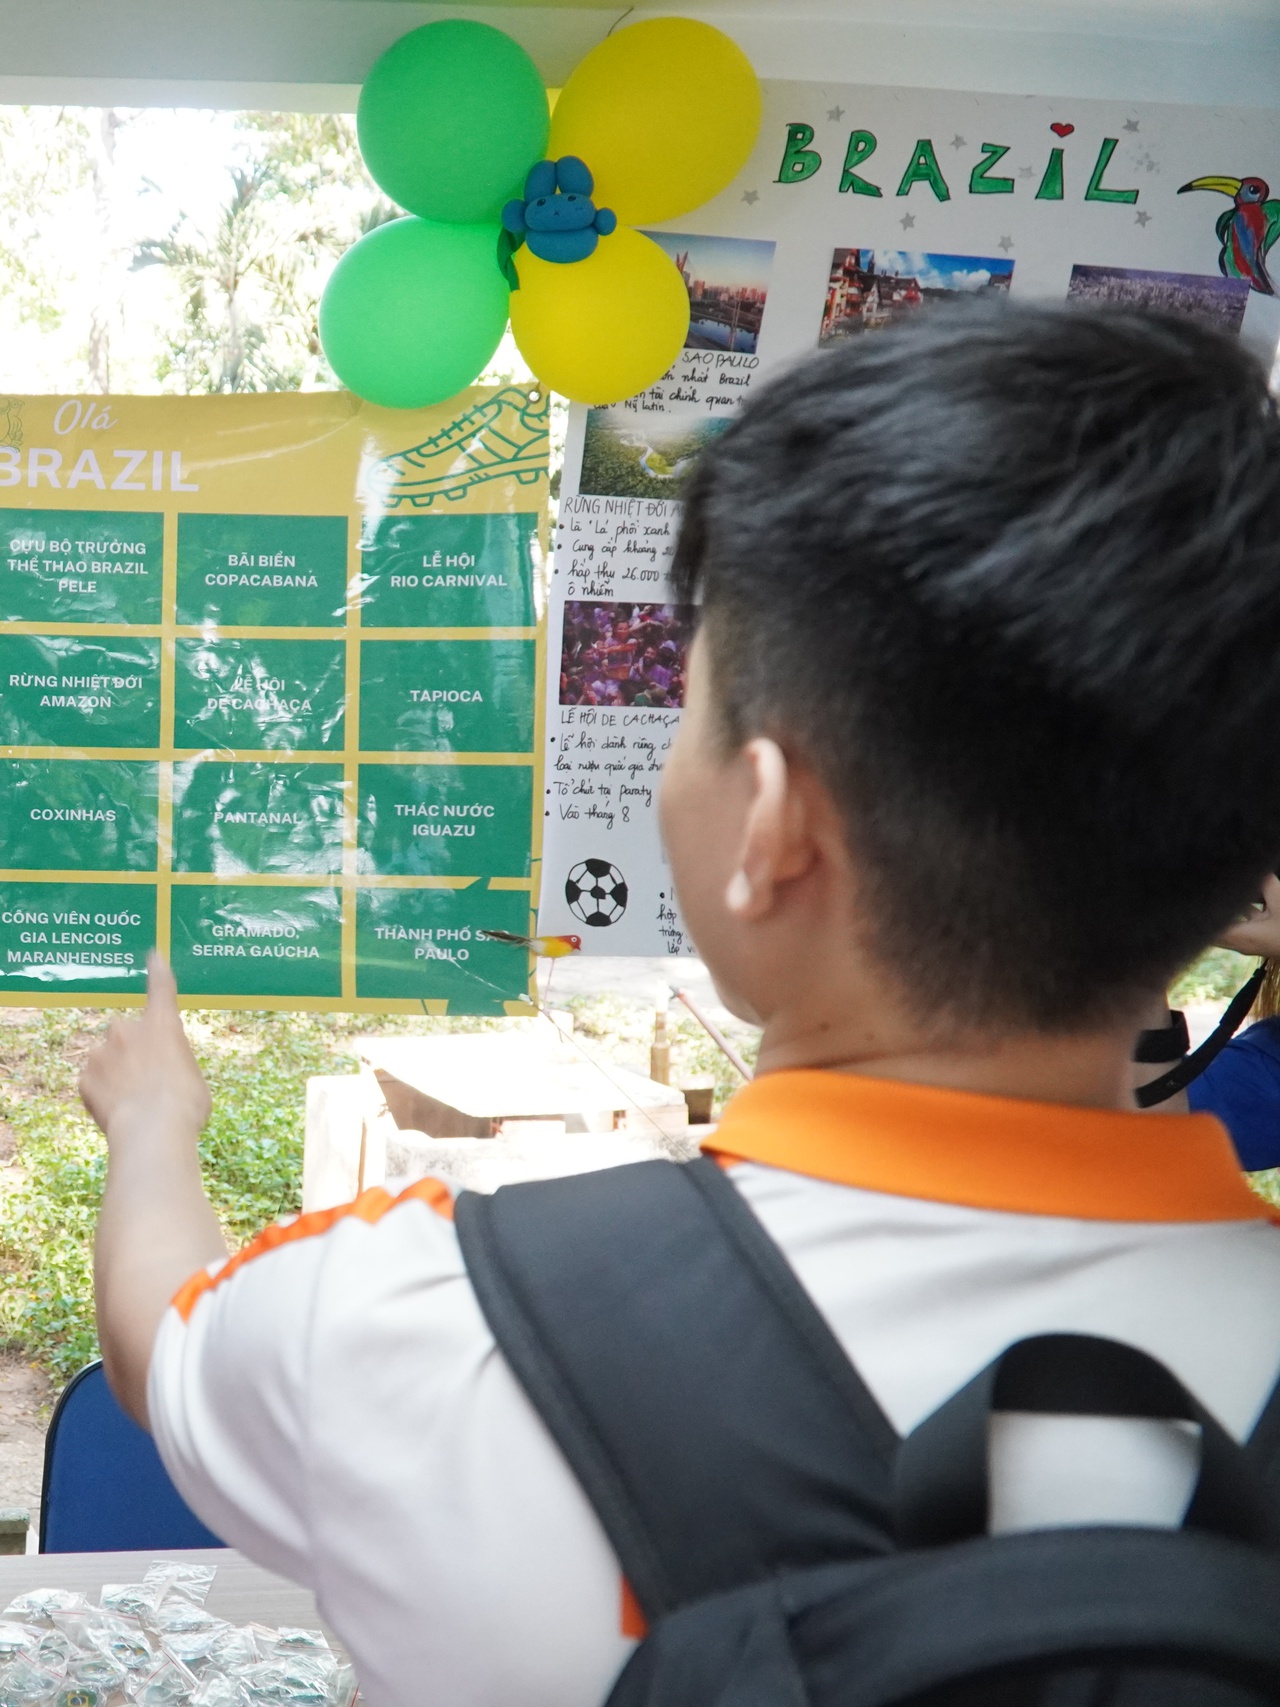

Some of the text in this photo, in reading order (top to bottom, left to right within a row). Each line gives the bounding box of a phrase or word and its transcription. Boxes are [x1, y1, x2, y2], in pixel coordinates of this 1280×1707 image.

[682, 353, 759, 368] SAO PAULO
[719, 370, 751, 386] Brazil
[54, 400, 119, 435] Olá
[644, 523, 670, 535] xanh
[10, 538, 146, 555] CỰU BỘ TRƯỞNG
[572, 539, 594, 560] Cung
[7, 555, 148, 574] THỂ THAO BRAZIL
[228, 551, 295, 567] BÃI BIỂN
[423, 551, 475, 569] LỄ HỘI
[58, 580, 96, 592] PELE
[205, 574, 318, 587] COPACABANA
[391, 574, 507, 586] RIO CARNIVAL
[10, 672, 142, 690] RỪNG NHIỆT ĐỚI
[40, 695, 111, 707] AMAZON
[410, 690, 482, 701] TAPIOCA
[208, 698, 312, 713] DE CACHAÇA
[602, 714, 616, 725] DE
[30, 808, 116, 821] COXINHAS
[214, 811, 301, 824] PANTANAL
[394, 802, 494, 818] THÁC NƯỚC
[622, 806, 630, 822] 8
[413, 824, 475, 836] IGUAZU
[2, 910, 141, 926] CÔNG VIÊN QUỐC
[20, 932, 122, 944] GIA LENCOIS
[212, 925, 299, 939] GRAMADO,
[374, 925, 432, 940] THÀNH
[437, 925, 471, 941] PHỐ
[8, 949, 134, 964] MARANHENSES
[192, 943, 319, 958] SERRA GAÚCHA
[415, 948, 469, 960] PAULO
